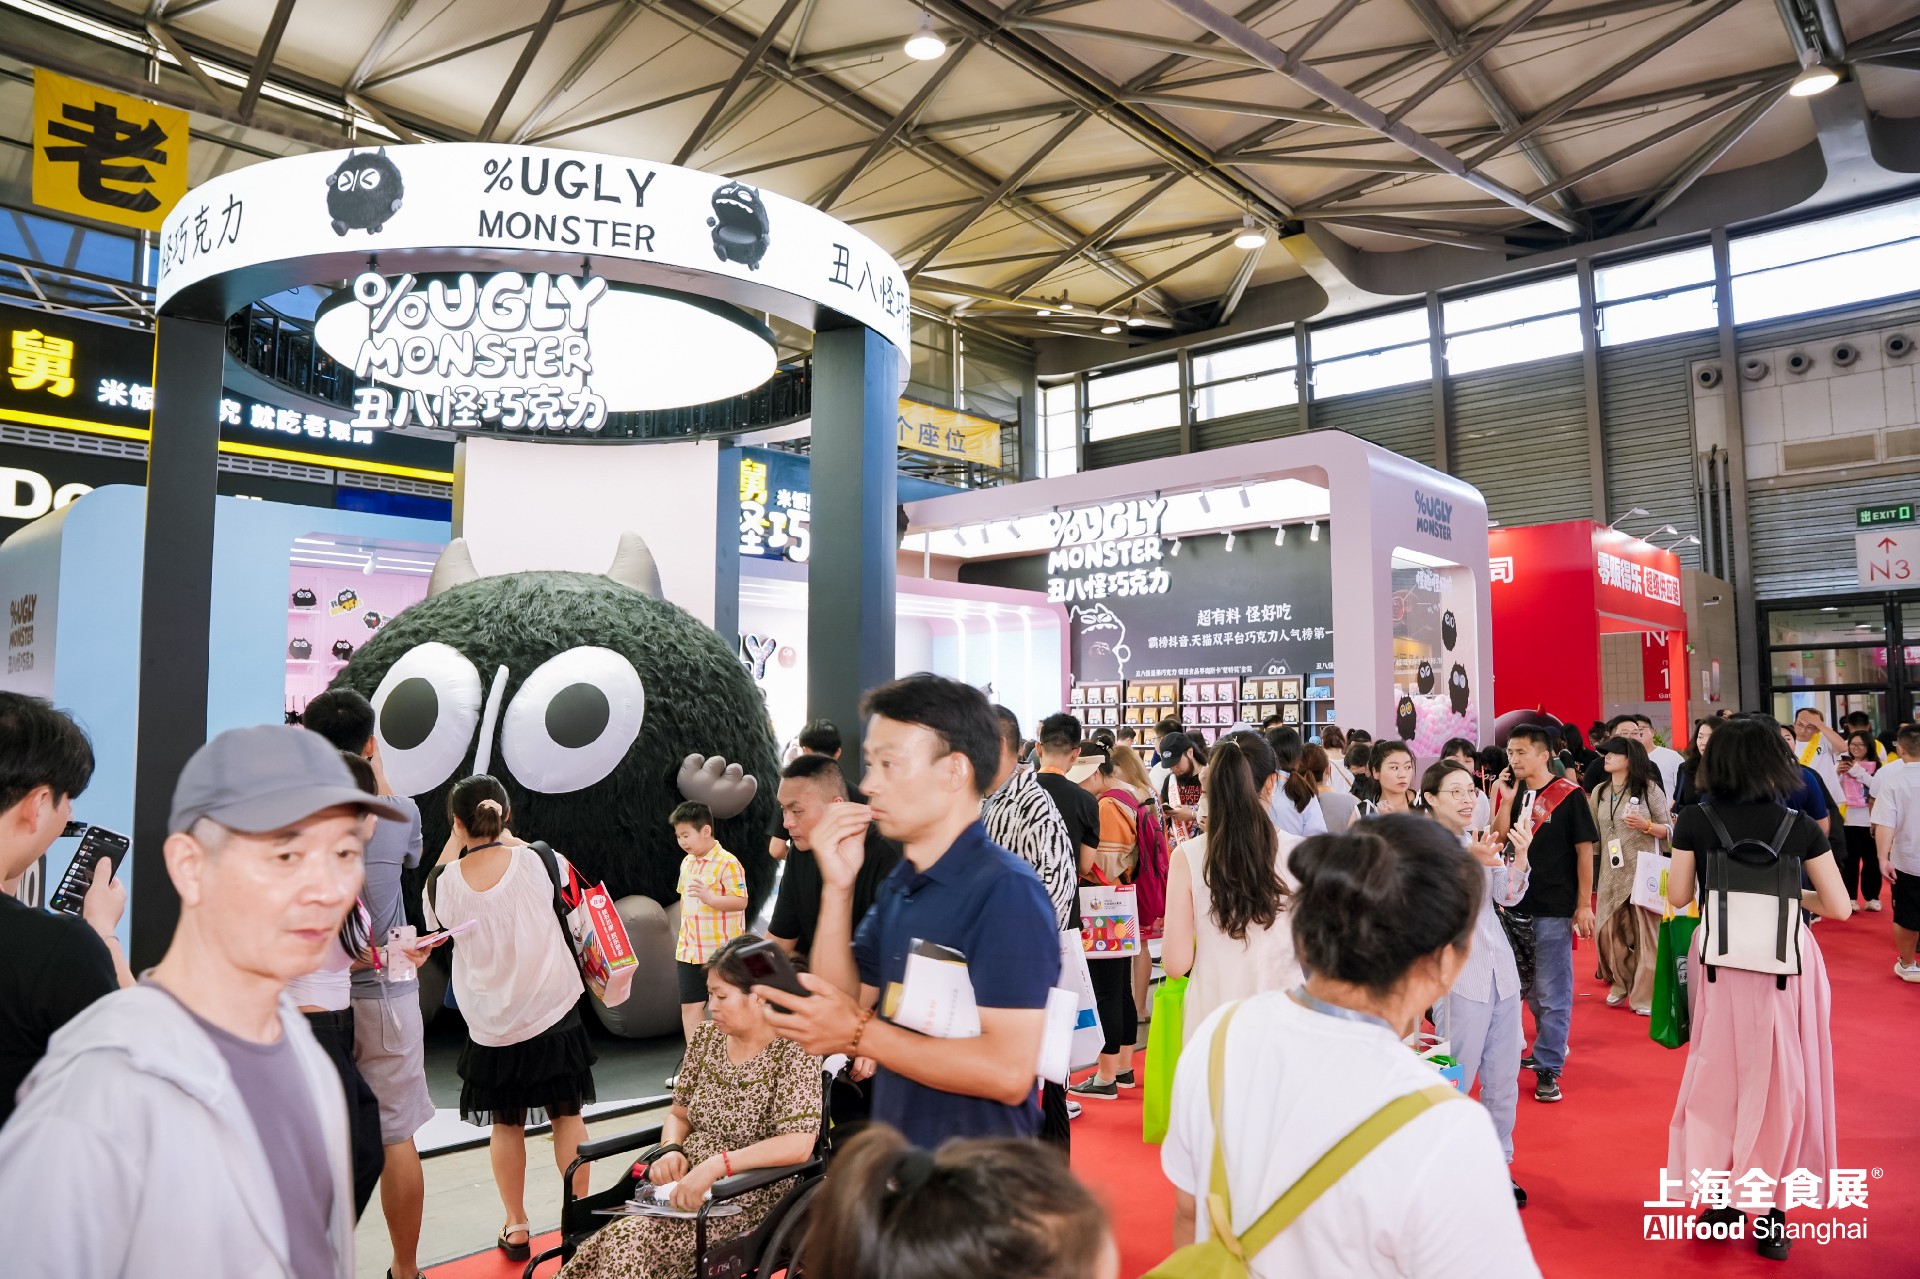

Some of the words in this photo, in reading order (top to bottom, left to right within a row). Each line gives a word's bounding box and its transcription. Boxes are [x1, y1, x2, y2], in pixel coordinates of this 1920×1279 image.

[44, 101, 168, 213] 老
[484, 156, 656, 208] %UGLY
[478, 209, 656, 253] MONSTER
[353, 271, 609, 334] %UGLY
[8, 329, 76, 398] 舅
[353, 334, 594, 380] MONSTER
[350, 384, 609, 432] 丑八怪巧克力
[897, 415, 966, 454] 个座位
[1047, 499, 1169, 548] %UGLY
[1415, 489, 1453, 525] %UGLY
[1872, 509, 1898, 521] EXIT
[1416, 517, 1452, 542] MONSTER
[1047, 536, 1164, 575] MONSTER
[1488, 556, 1515, 584] 司
[1869, 558, 1912, 582] N3
[1047, 566, 1172, 604] 丑八怪巧克力
[1196, 607, 1242, 627] 超有料
[1245, 602, 1292, 624] 怪好吃
[1645, 630, 1669, 648] N
